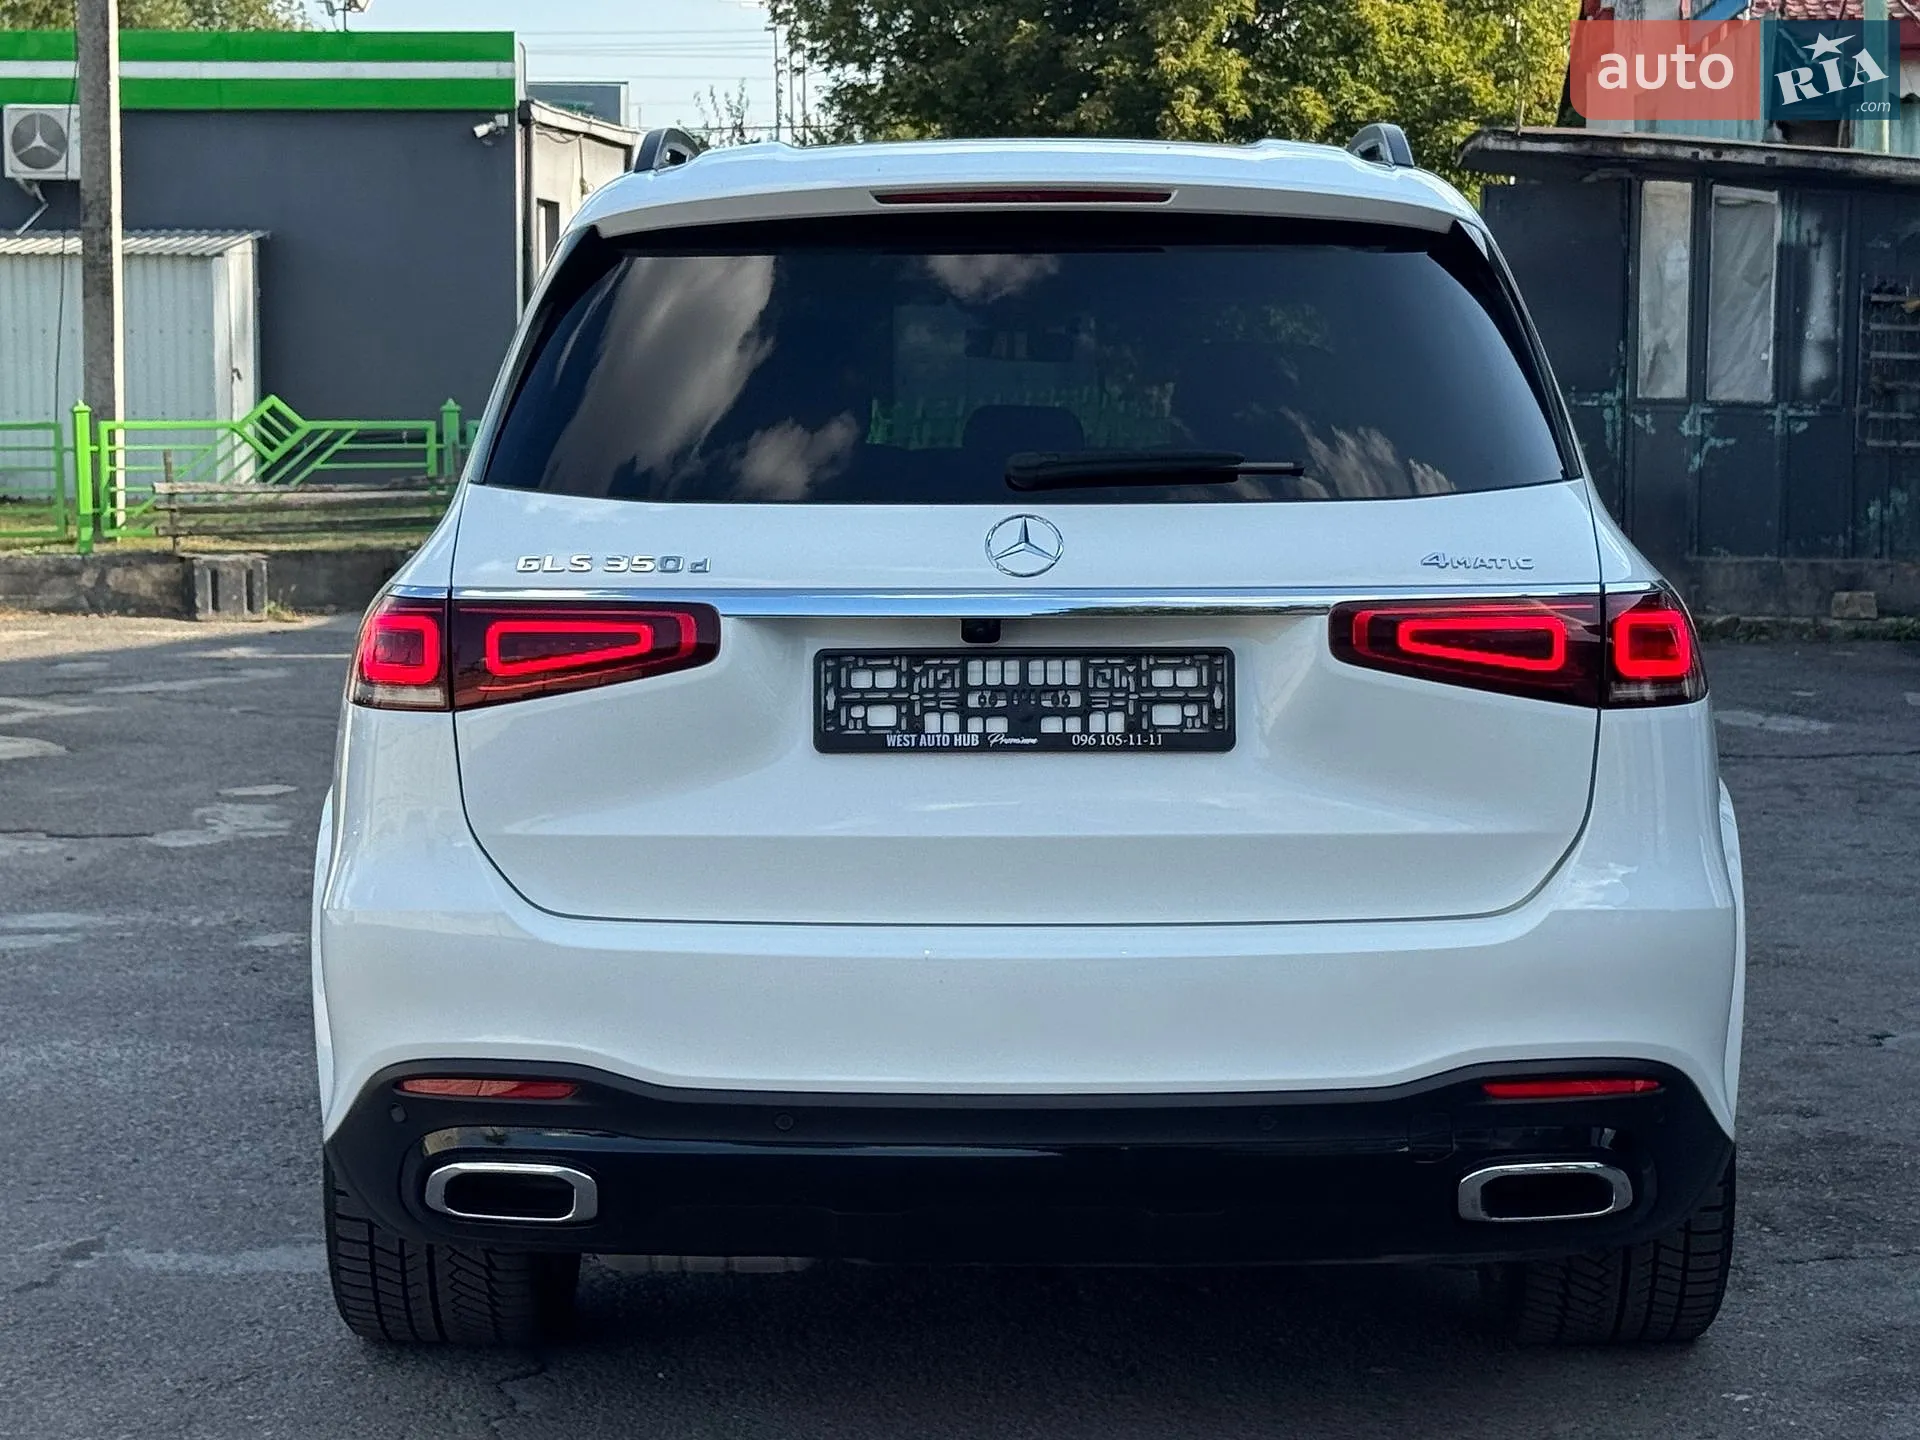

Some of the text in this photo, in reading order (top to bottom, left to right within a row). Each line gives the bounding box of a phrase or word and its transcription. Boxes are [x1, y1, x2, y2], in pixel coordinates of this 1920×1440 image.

[516, 554, 593, 573] GLS
[1420, 552, 1535, 570] 4MATIC
[886, 733, 917, 747] WEST
[919, 733, 950, 747] AUTO
[953, 733, 980, 747] HUB
[1071, 733, 1162, 747] 096 105-11-11
